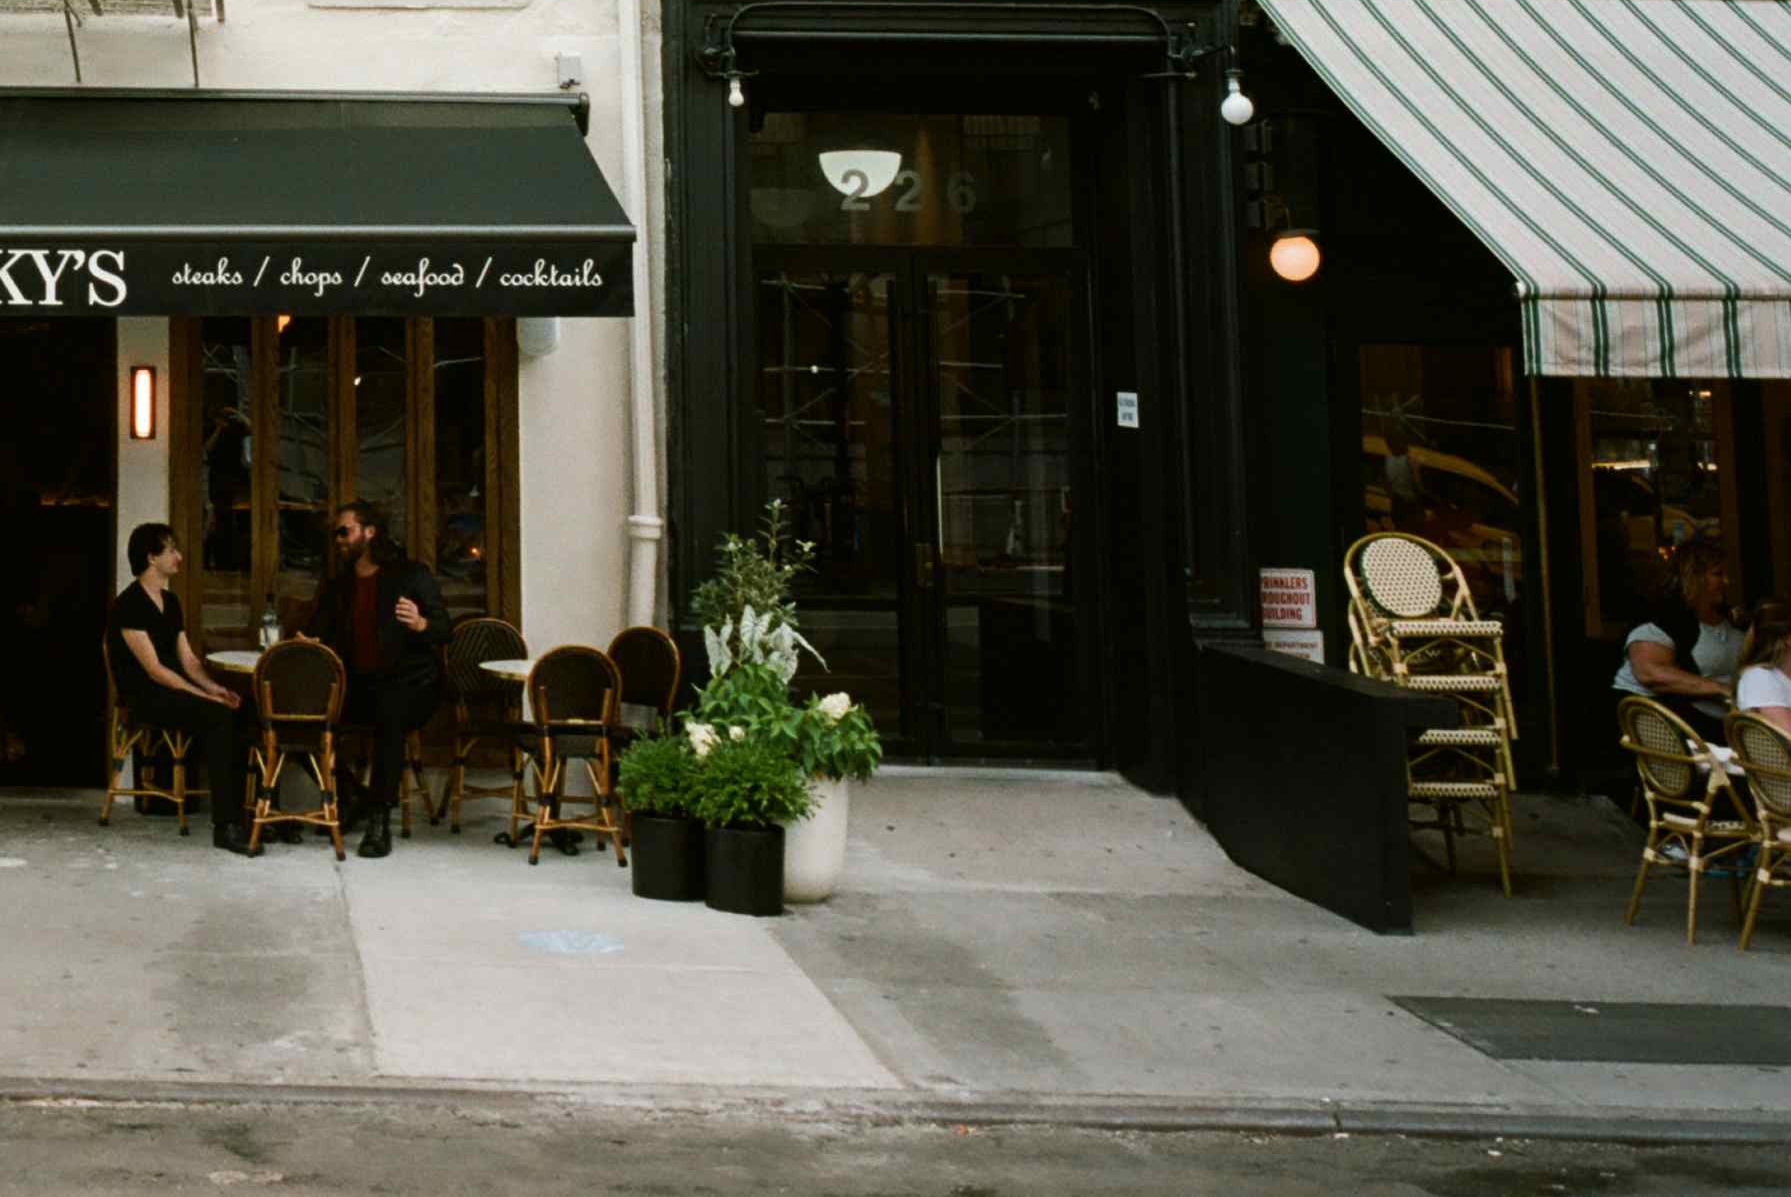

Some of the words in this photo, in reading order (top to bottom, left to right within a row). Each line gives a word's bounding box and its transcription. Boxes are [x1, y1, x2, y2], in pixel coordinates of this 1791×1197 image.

[840, 168, 977, 214] 226
[172, 258, 244, 286] steaks
[280, 257, 343, 297] chops
[381, 257, 465, 298] seafood
[499, 259, 603, 287] cocktails
[1263, 576, 1308, 590] RINKLERS
[1263, 592, 1311, 605] ROUGHOUT
